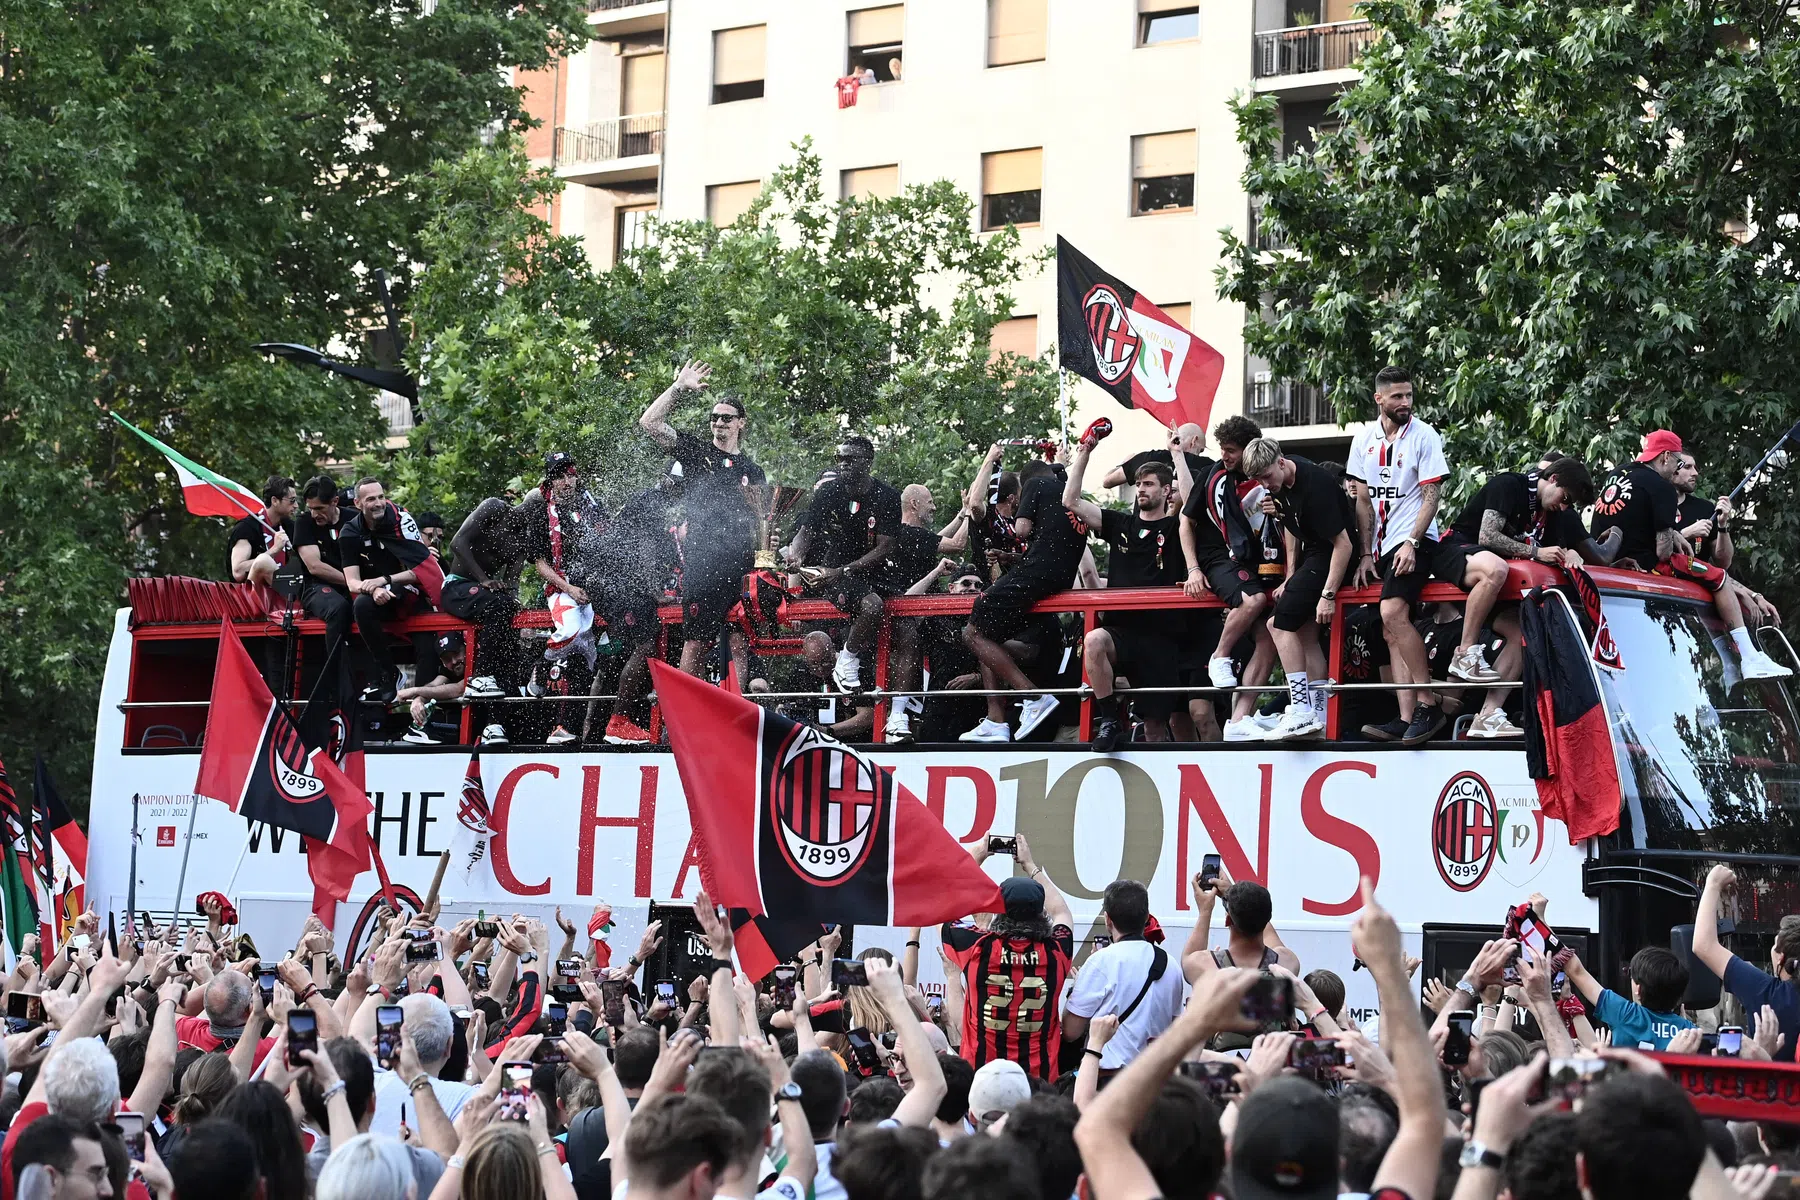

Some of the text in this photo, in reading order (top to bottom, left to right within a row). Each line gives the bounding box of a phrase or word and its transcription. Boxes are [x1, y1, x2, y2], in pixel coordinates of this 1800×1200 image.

[1096, 353, 1118, 375] 1899
[1368, 486, 1407, 499] OPEL
[281, 770, 317, 792] 1899
[1448, 781, 1484, 803] ACM
[150, 808, 166, 817] 2021
[172, 808, 188, 817] 2022
[364, 791, 445, 857] HE
[1511, 824, 1530, 848] 19
[799, 845, 851, 866] 1899
[1448, 863, 1479, 877] 1899
[1000, 946, 1040, 966] KAKA
[983, 974, 1049, 1033] 22
